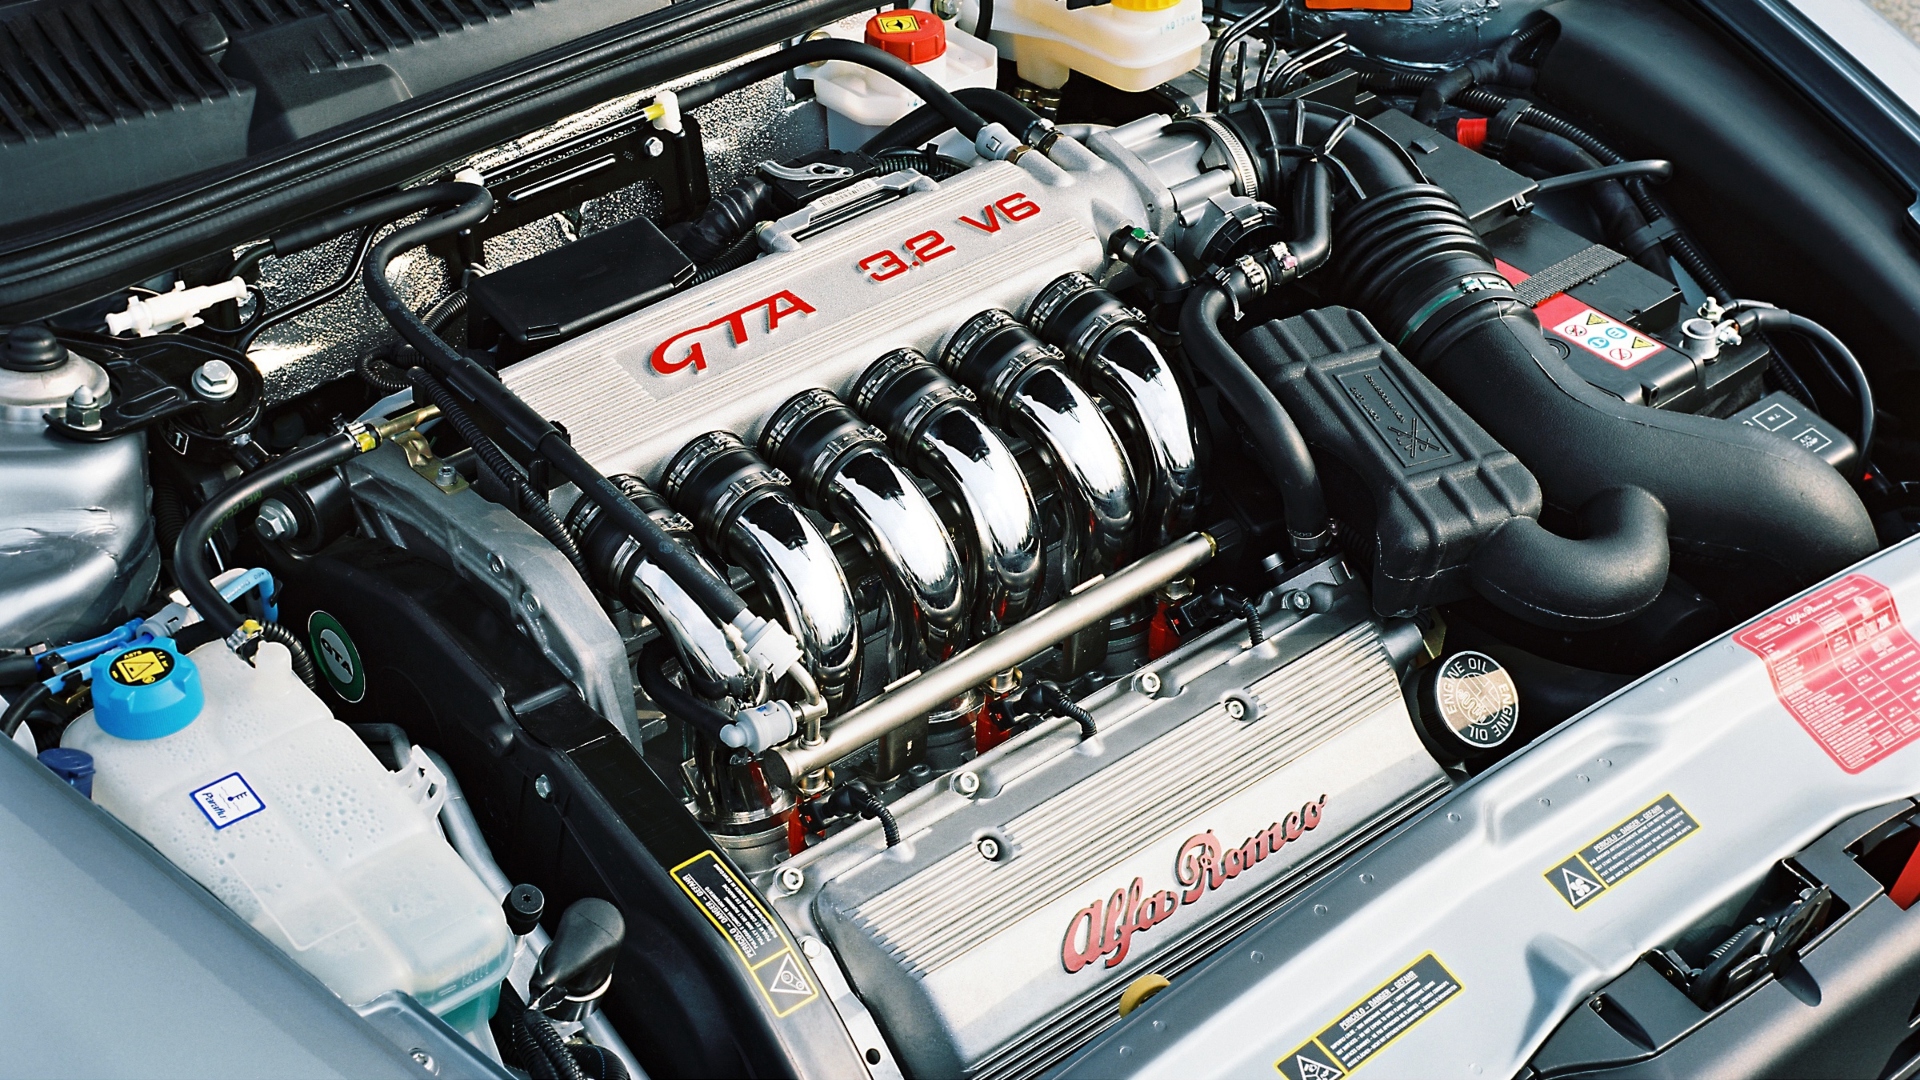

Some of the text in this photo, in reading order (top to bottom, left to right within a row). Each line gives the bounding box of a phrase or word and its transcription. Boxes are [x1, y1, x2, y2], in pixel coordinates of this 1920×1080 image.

[860, 191, 1041, 286] 3.2 V6
[649, 289, 816, 377] GTA
[320, 637, 353, 677] GTA
[1443, 657, 1488, 715] ENGINE OIL
[1467, 683, 1515, 741] ENGINE OIL
[1594, 834, 1618, 852] PERICOLO
[1620, 819, 1641, 835] DANGER
[1643, 805, 1662, 820] GEFAHR
[683, 875, 703, 896] GEFAHR
[1061, 793, 1328, 975] Alfa Romeo
[706, 901, 727, 923] DANGER
[738, 913, 747, 922] BELT
[746, 922, 754, 930] AND
[730, 928, 755, 958] PERICOLO
[743, 929, 758, 949] PULEGGIA
[752, 930, 765, 945] PULLEY
[1340, 1008, 1366, 1029] PERICOLO
[1368, 989, 1391, 1008] DANGER
[1394, 971, 1416, 989] GEFAHR
